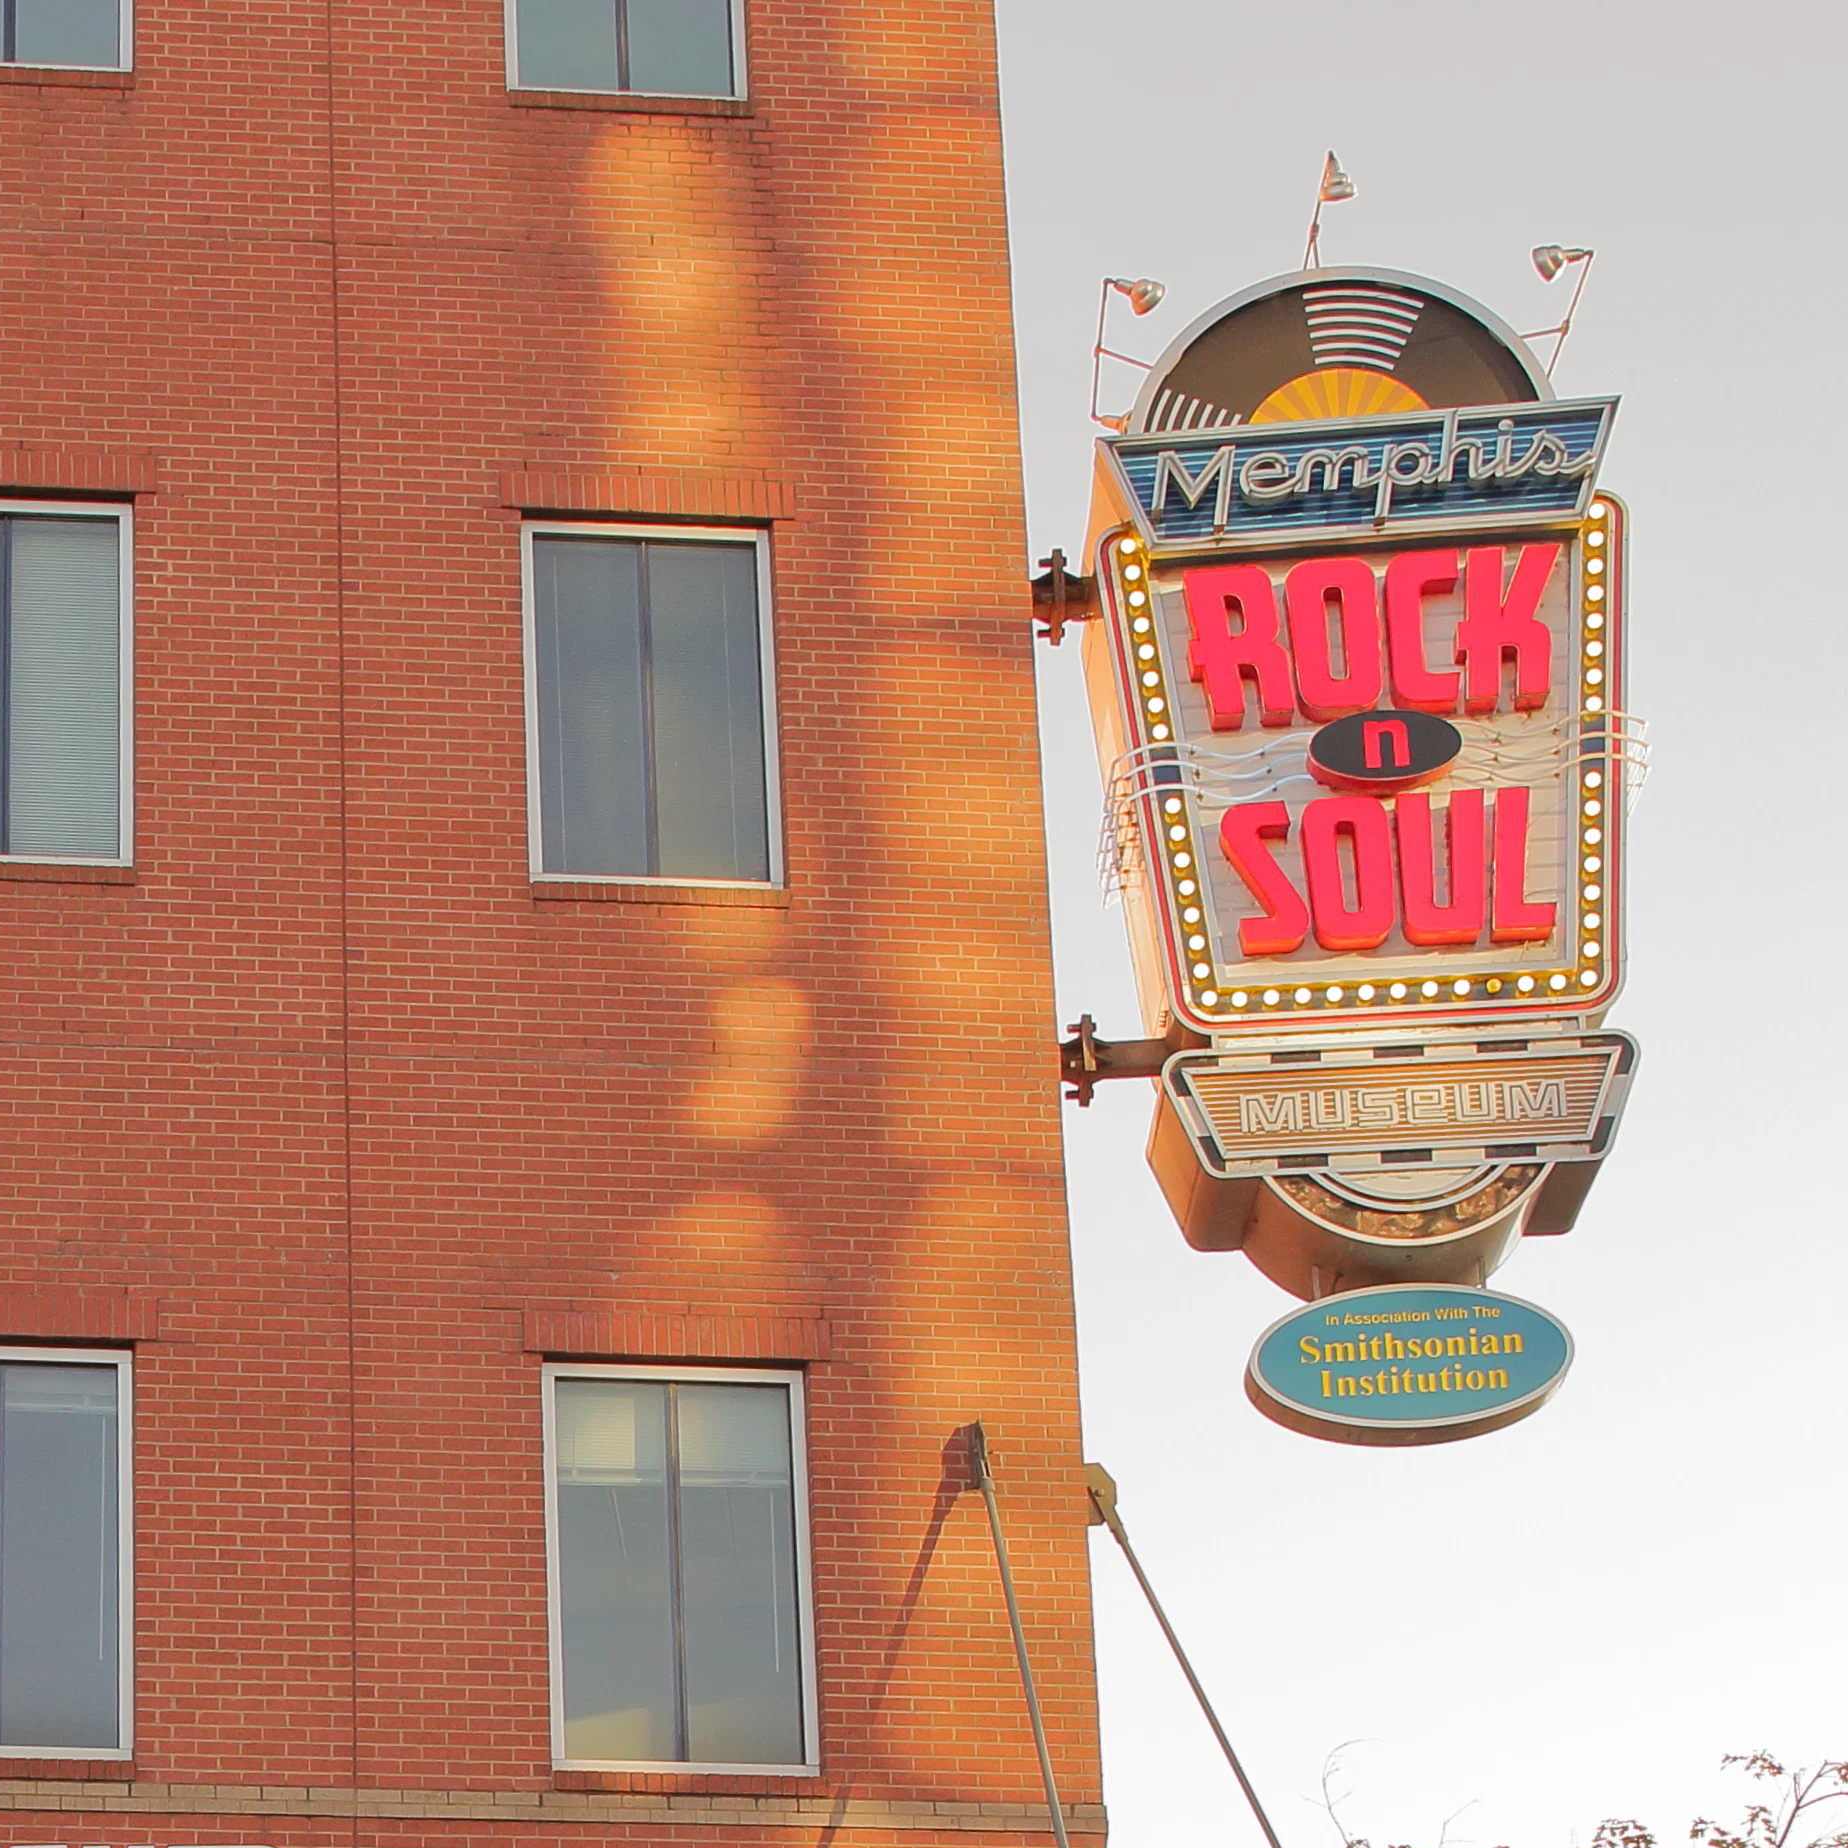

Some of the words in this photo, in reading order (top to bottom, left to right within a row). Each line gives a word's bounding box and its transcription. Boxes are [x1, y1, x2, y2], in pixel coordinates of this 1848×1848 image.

[1152, 409, 1595, 530] Memphis
[1183, 545, 1561, 728] ROCK
[1362, 717, 1412, 769] n
[1220, 786, 1559, 956] SOUL
[1238, 1079, 1568, 1134] MUSEUM
[1325, 1314, 1339, 1326] In
[1343, 1310, 1431, 1326] Association
[1435, 1307, 1468, 1321] With
[1472, 1305, 1501, 1318] The
[1299, 1327, 1523, 1364] Smithsonian
[1320, 1363, 1509, 1398] Institution
